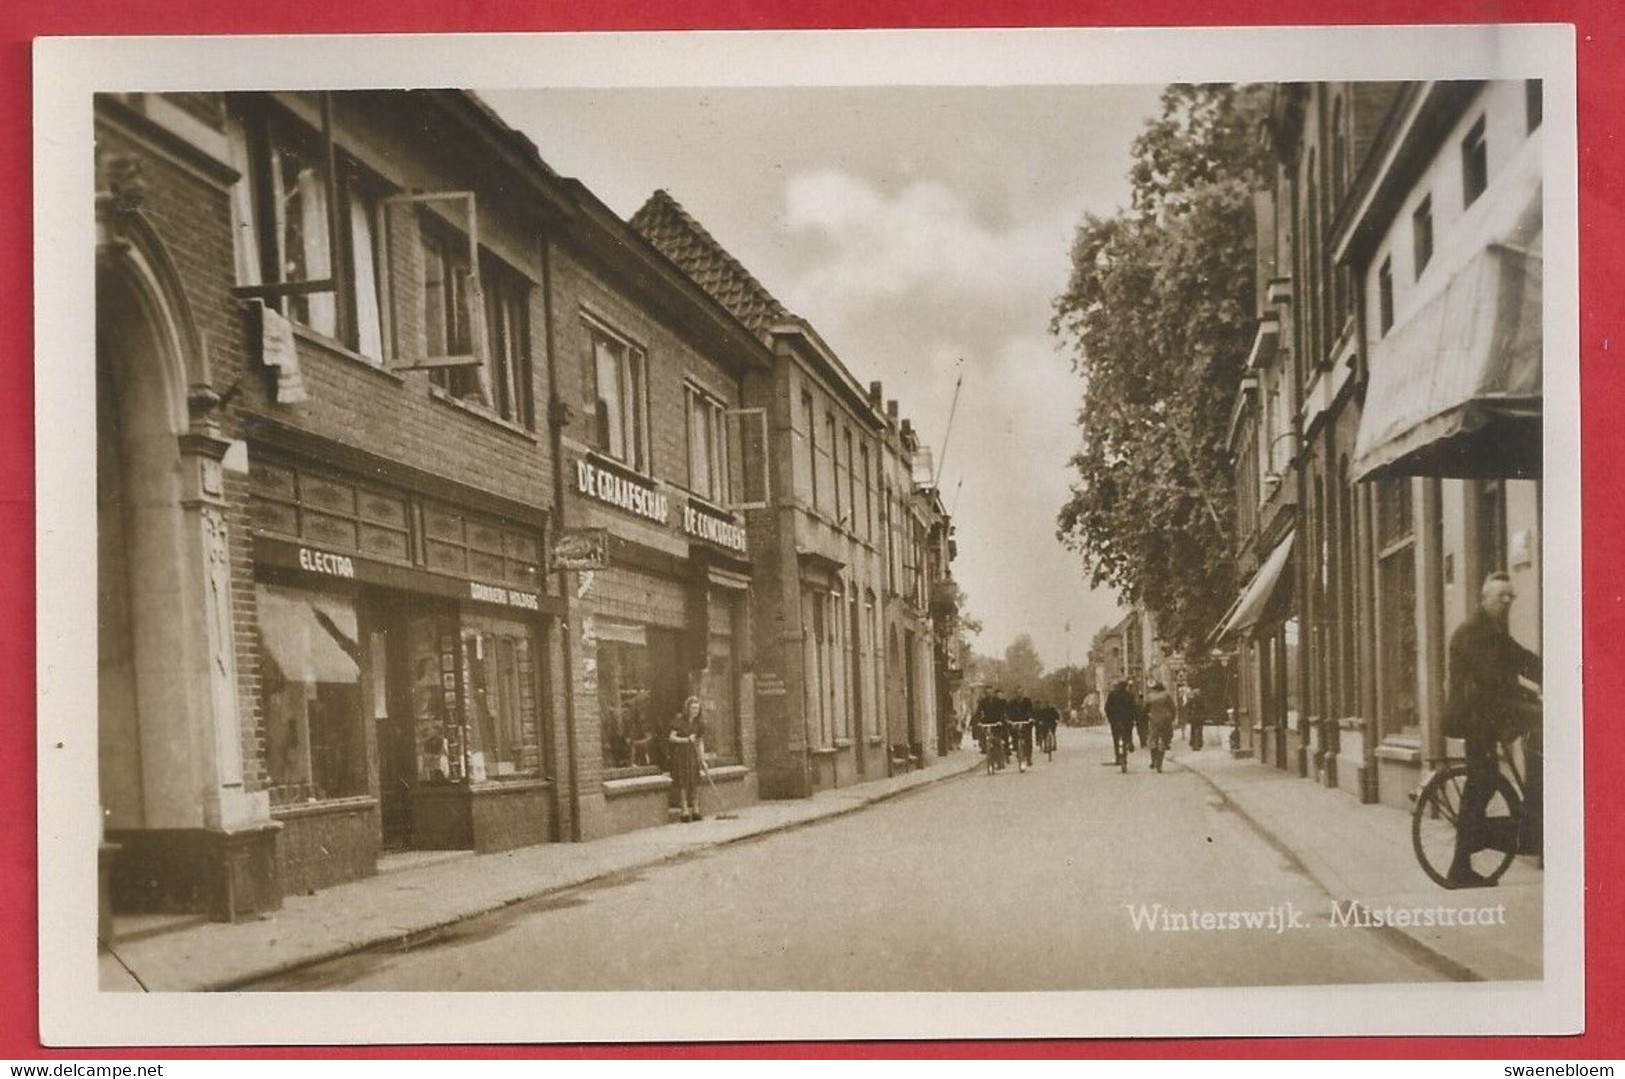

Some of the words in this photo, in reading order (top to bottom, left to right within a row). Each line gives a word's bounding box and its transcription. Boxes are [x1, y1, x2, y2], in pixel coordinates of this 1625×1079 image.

[577, 459, 596, 497] DE
[597, 469, 669, 525] GRAAFSCHAP
[683, 506, 697, 536] DE
[298, 547, 355, 579] ELECTRA
